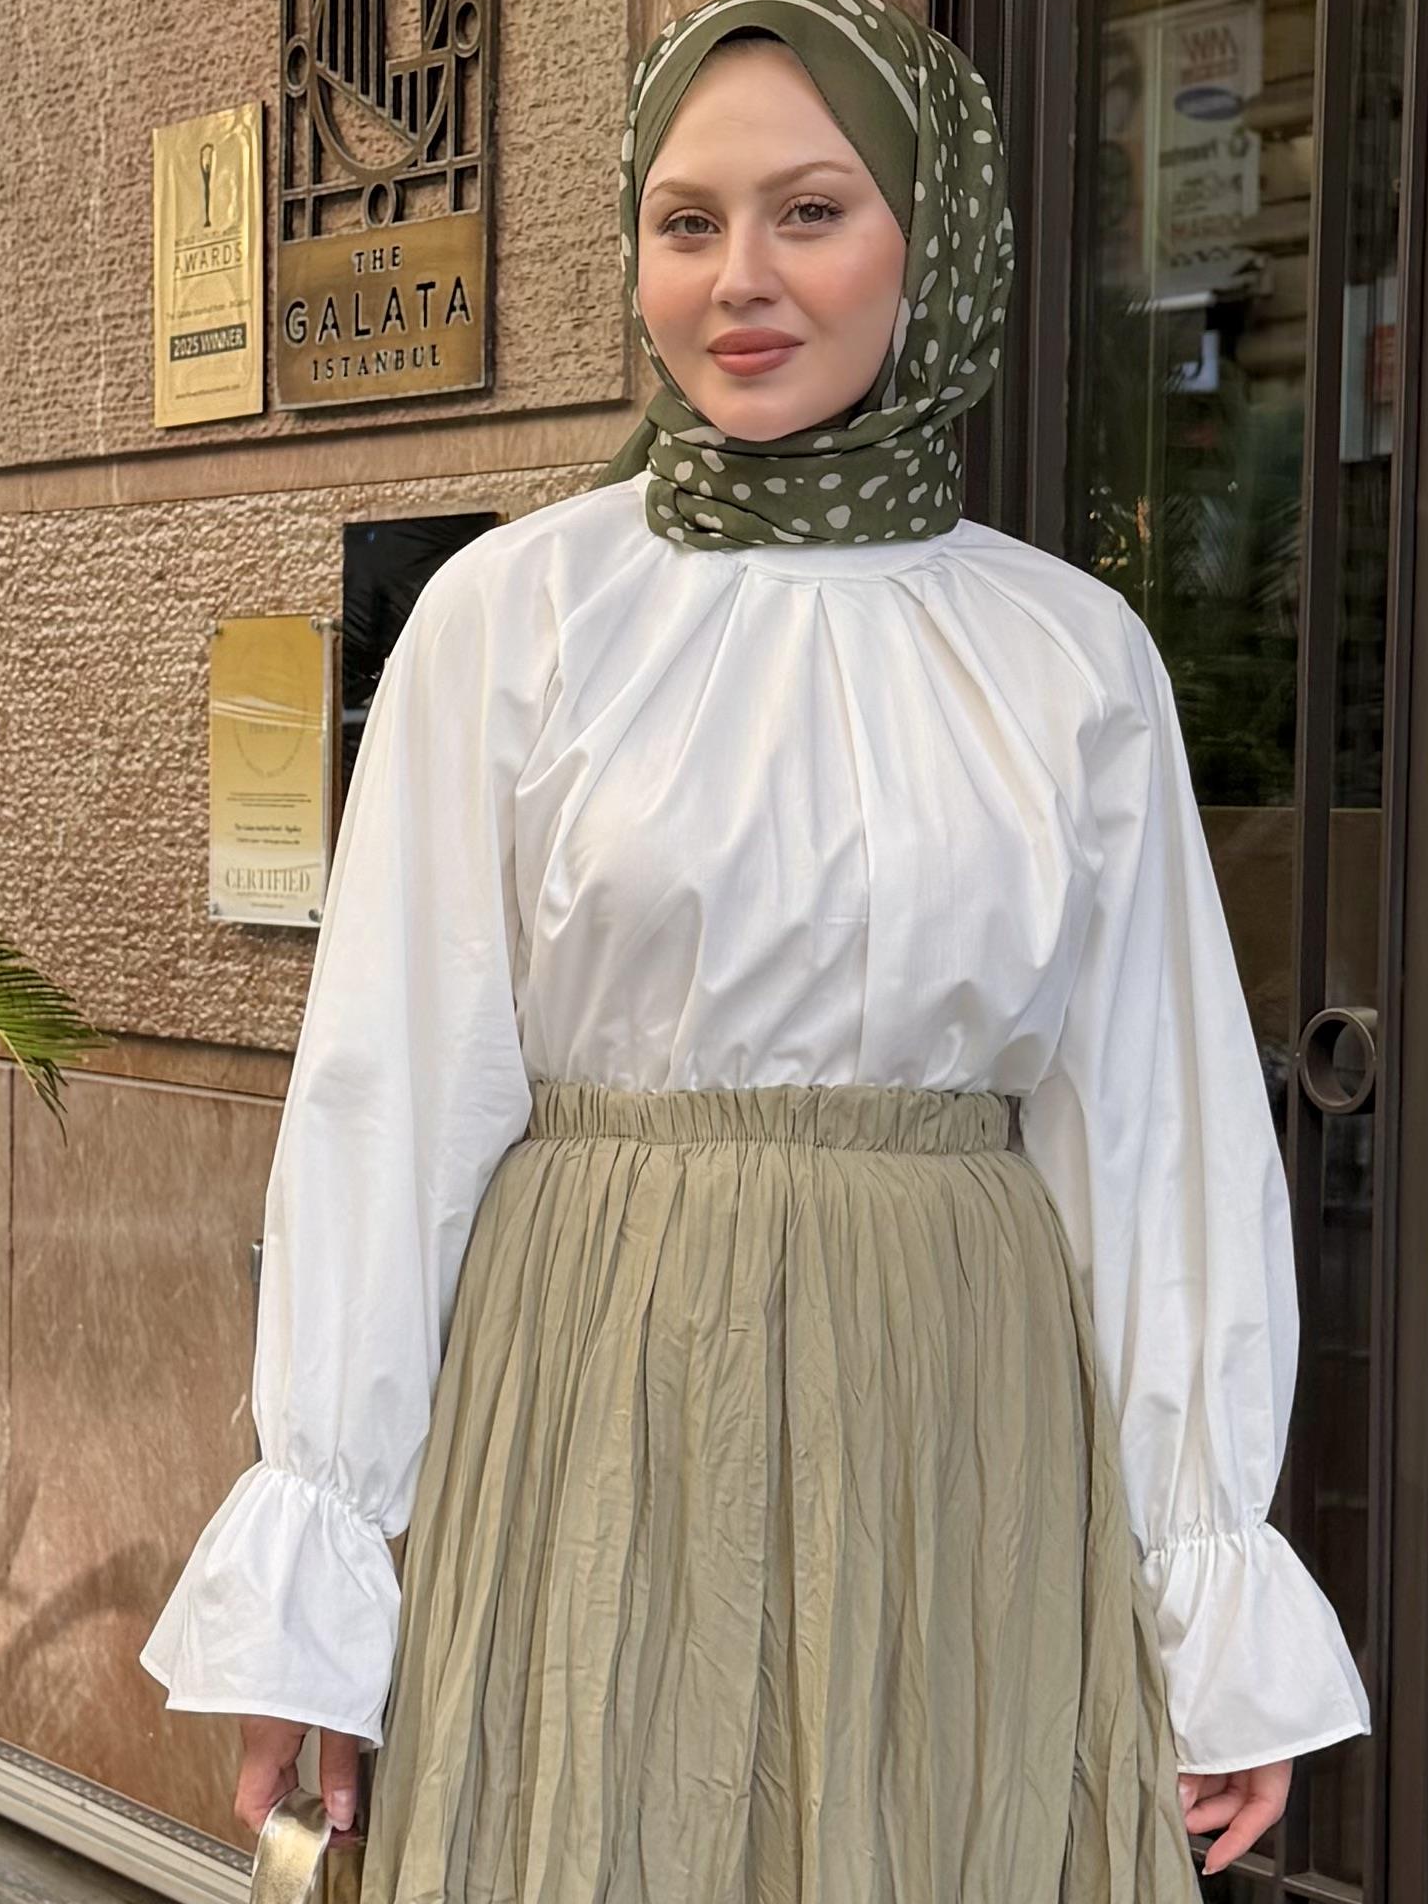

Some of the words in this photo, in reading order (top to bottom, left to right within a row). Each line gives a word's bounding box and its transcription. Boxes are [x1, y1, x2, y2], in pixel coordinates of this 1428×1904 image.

[173, 241, 243, 274] AWARDS
[354, 245, 403, 273] THE
[285, 276, 471, 344] GALATA
[173, 337, 199, 358] 2025
[199, 328, 244, 353] WINNER
[312, 344, 441, 381] ISTANBUL
[226, 868, 311, 893] CERTIFIED
